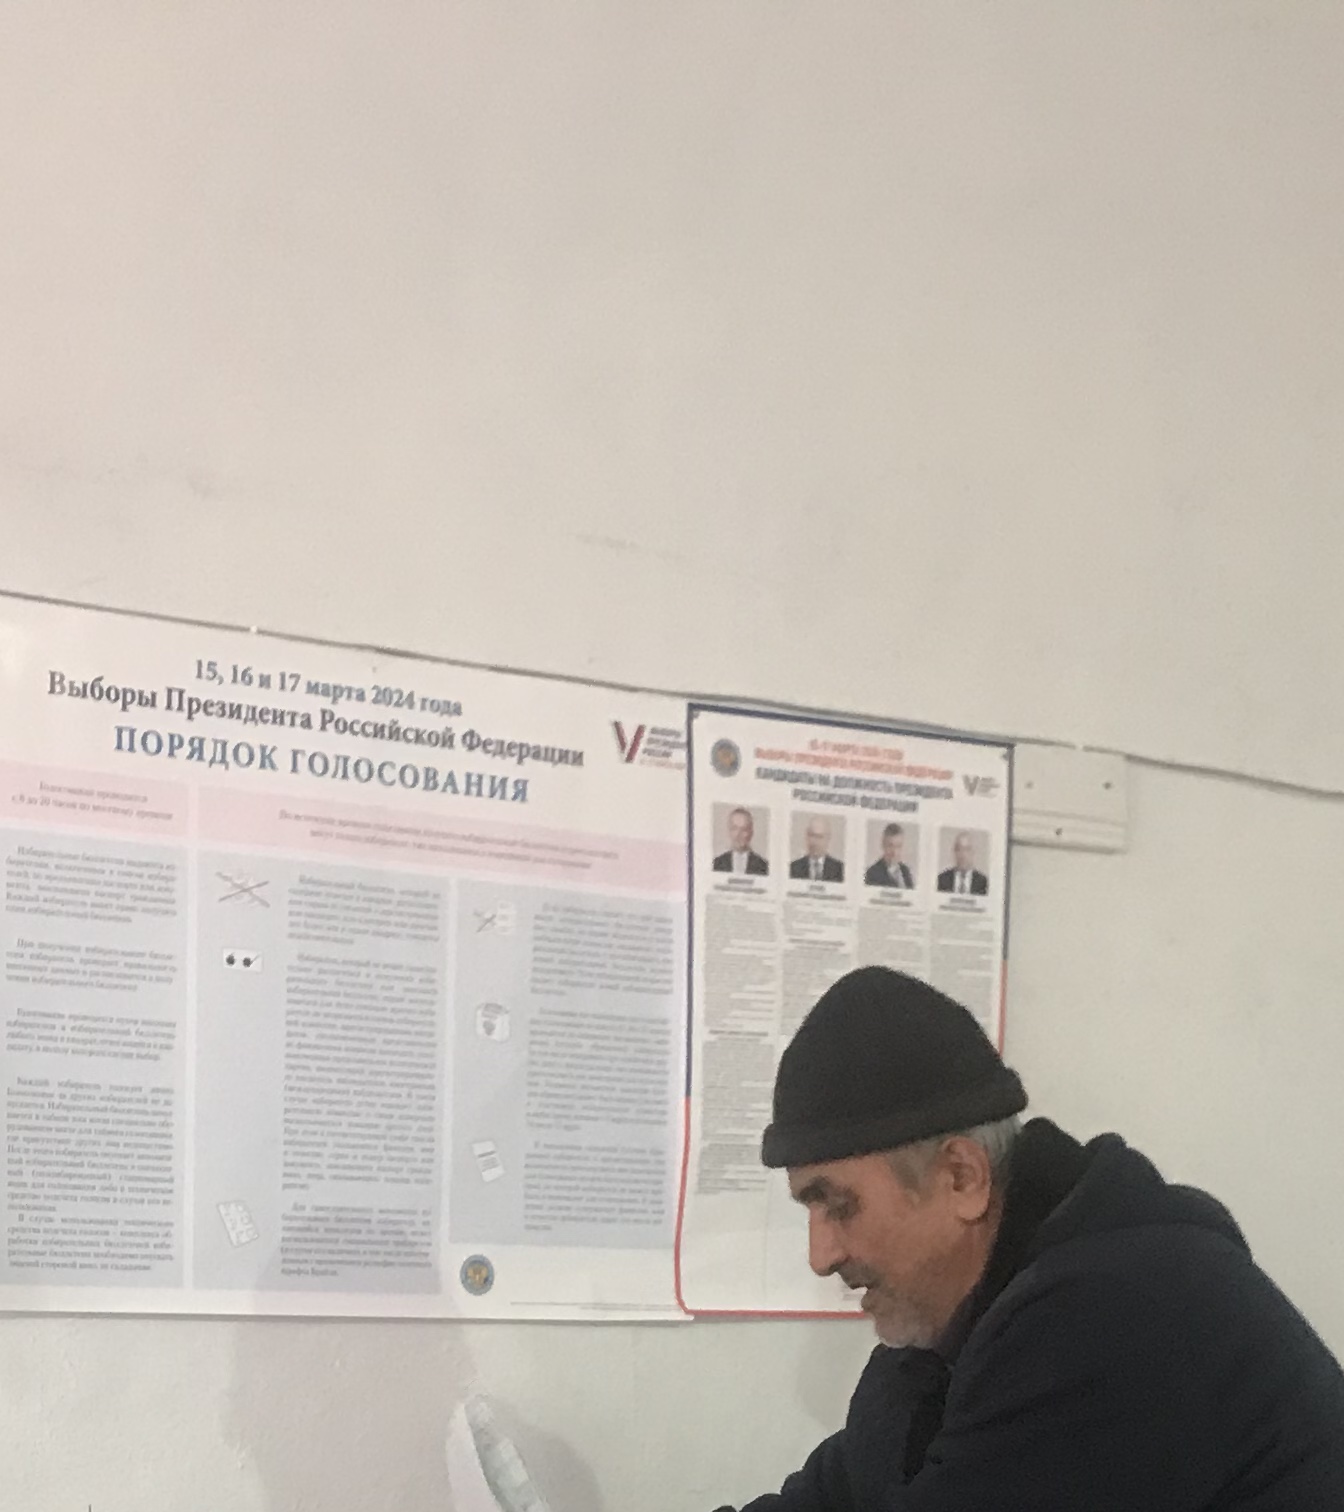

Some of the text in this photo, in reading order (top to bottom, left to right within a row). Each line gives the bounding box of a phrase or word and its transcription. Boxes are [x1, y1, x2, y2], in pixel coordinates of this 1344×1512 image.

[47, 670, 584, 767] Выборы Президента Российской Федерации
[196, 659, 463, 717] 15, 16 и 17 марта 2024 года
[114, 725, 529, 803] ПОРЯДОК ГОЛОСОВАНИЯ
